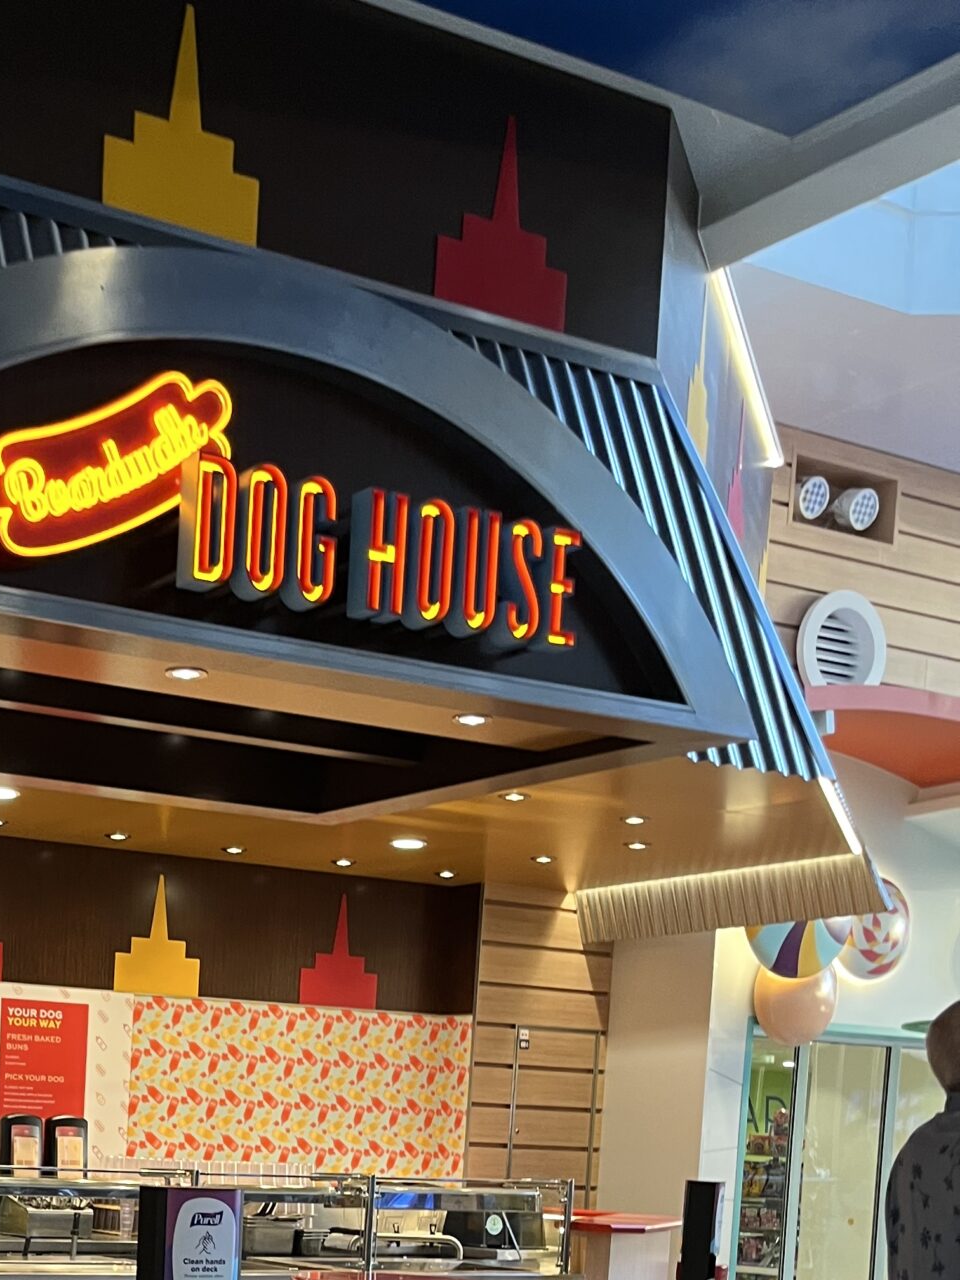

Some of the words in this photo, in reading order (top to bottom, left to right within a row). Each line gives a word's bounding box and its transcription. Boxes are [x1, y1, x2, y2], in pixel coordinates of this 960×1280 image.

[3, 403, 209, 523] Boardwalk
[187, 452, 338, 604] DOG
[365, 485, 583, 648] HOUSE
[7, 1007, 37, 1017] YOUR
[39, 1009, 63, 1019] DOG
[7, 1017, 37, 1027] YOUR
[39, 1019, 61, 1028] WAY
[6, 1033, 32, 1041] FRESH
[34, 1035, 61, 1043] BAKED
[6, 1043, 29, 1051] BUNS
[4, 1072, 23, 1080] PICK
[25, 1074, 46, 1082] YOUR
[201, 1265, 218, 1273] deck
